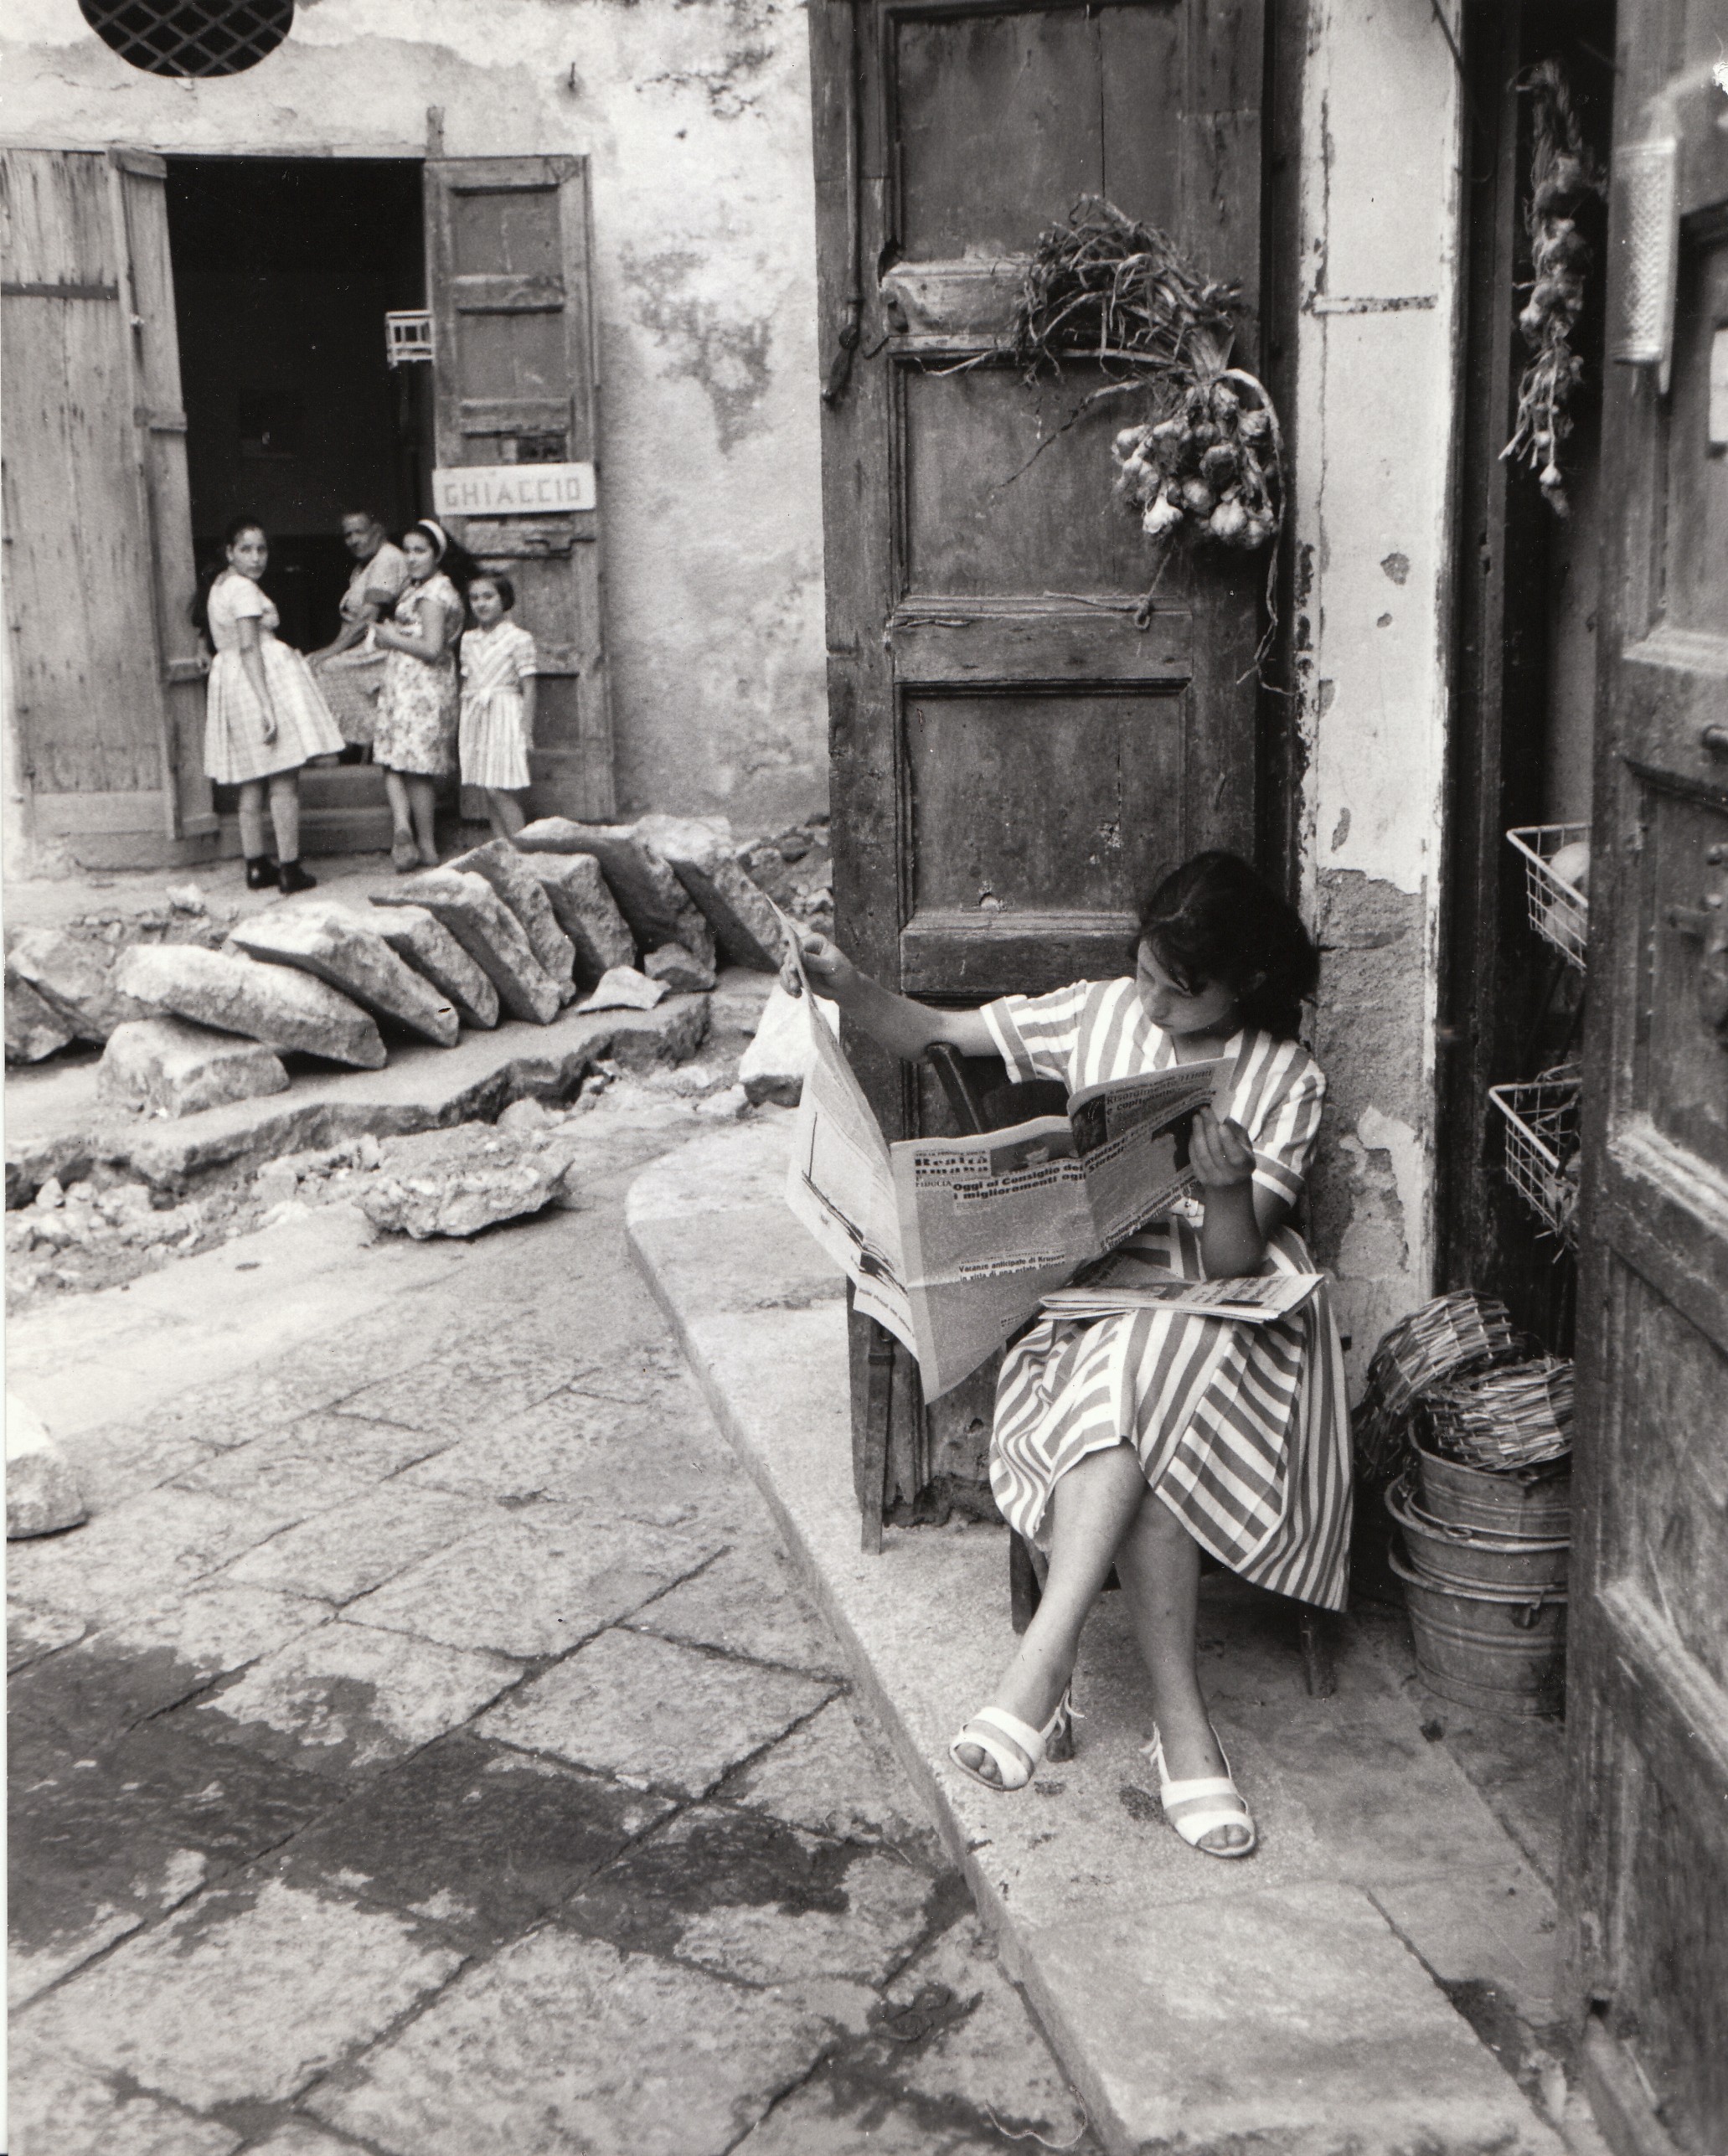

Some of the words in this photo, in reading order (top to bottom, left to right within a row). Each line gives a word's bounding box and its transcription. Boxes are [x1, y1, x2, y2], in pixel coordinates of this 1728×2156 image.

[443, 477, 580, 507] GHIACCIO
[953, 1181, 983, 1191] Oggi
[987, 1179, 998, 1188] al
[1002, 1165, 1060, 1186] Consiglio
[1063, 1163, 1084, 1172] dei
[963, 1175, 1058, 1199] miglioramenti
[1062, 1173, 1086, 1181] agli
[958, 1263, 989, 1272] Vacanze
[991, 1258, 1026, 1269] anticipate
